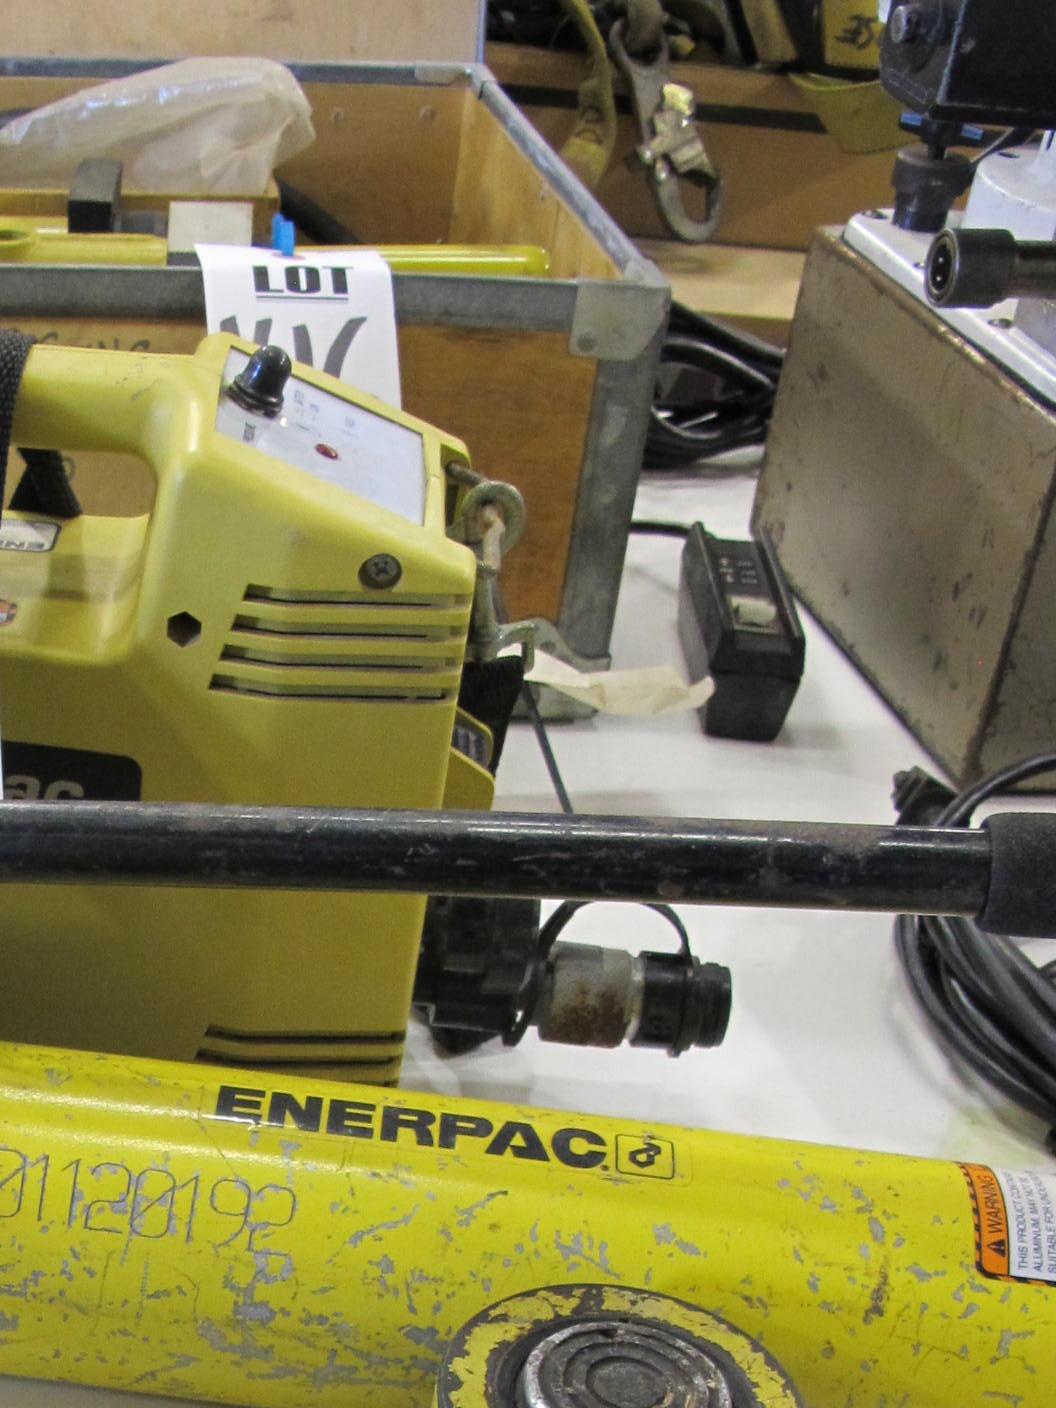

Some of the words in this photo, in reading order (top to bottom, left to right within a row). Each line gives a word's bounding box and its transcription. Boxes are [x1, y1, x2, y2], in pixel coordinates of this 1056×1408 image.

[252, 265, 353, 294] LOT
[215, 1085, 607, 1169] ENERPAC
[977, 1174, 1003, 1234] WARNING
[1013, 1200, 1027, 1244] PRODUCT
[1017, 1245, 1029, 1270] THIS
